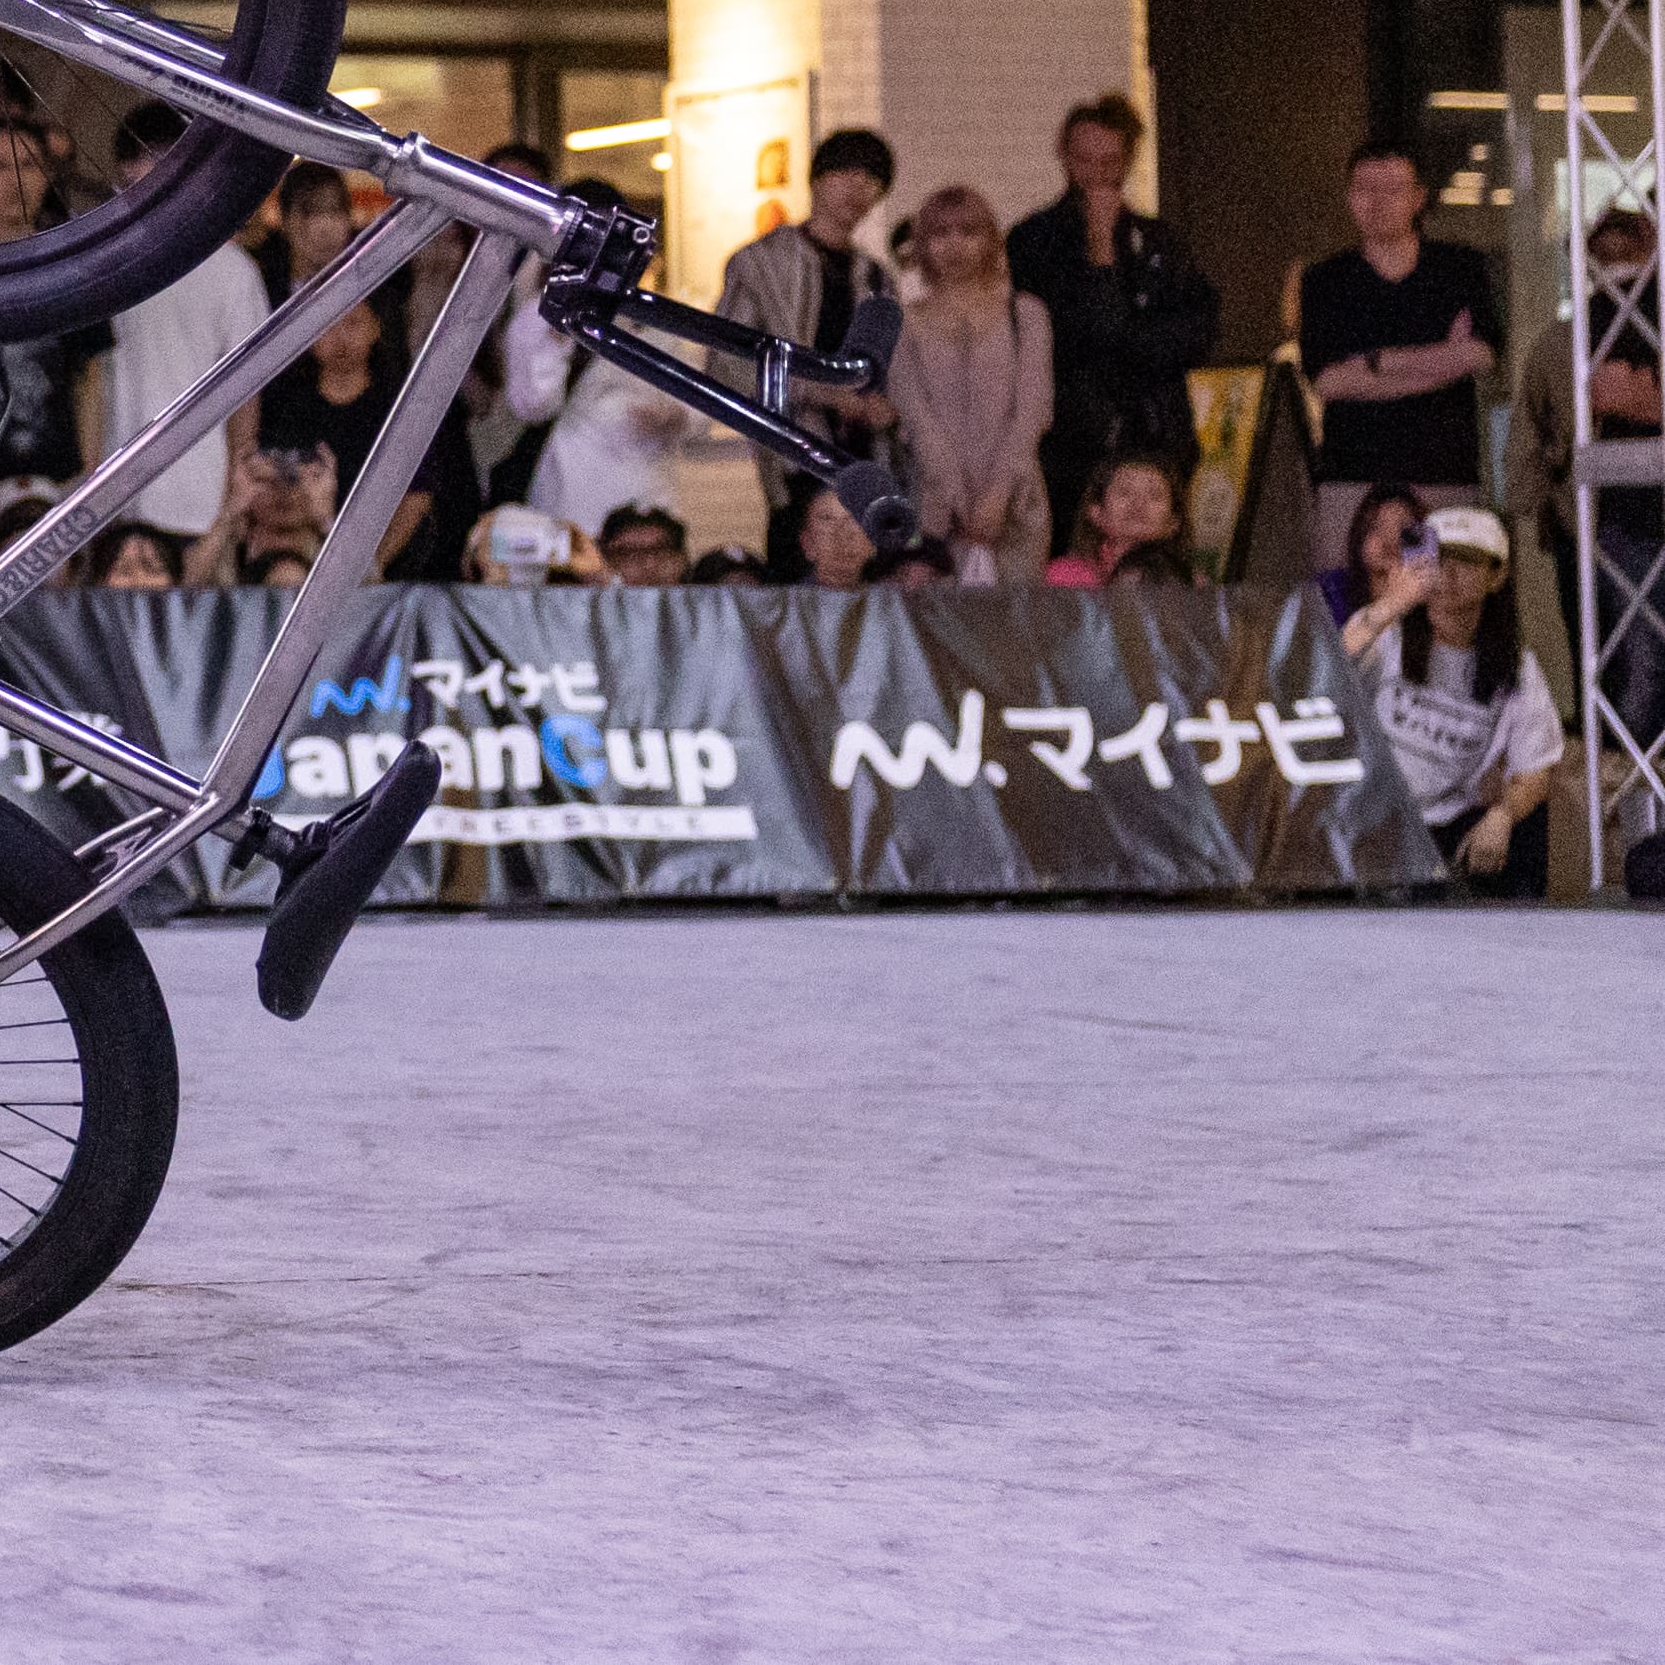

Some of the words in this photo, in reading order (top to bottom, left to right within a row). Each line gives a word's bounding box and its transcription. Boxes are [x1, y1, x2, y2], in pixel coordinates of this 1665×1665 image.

[412, 659, 606, 712] マイナビ
[1004, 696, 1365, 789] マイナビ
